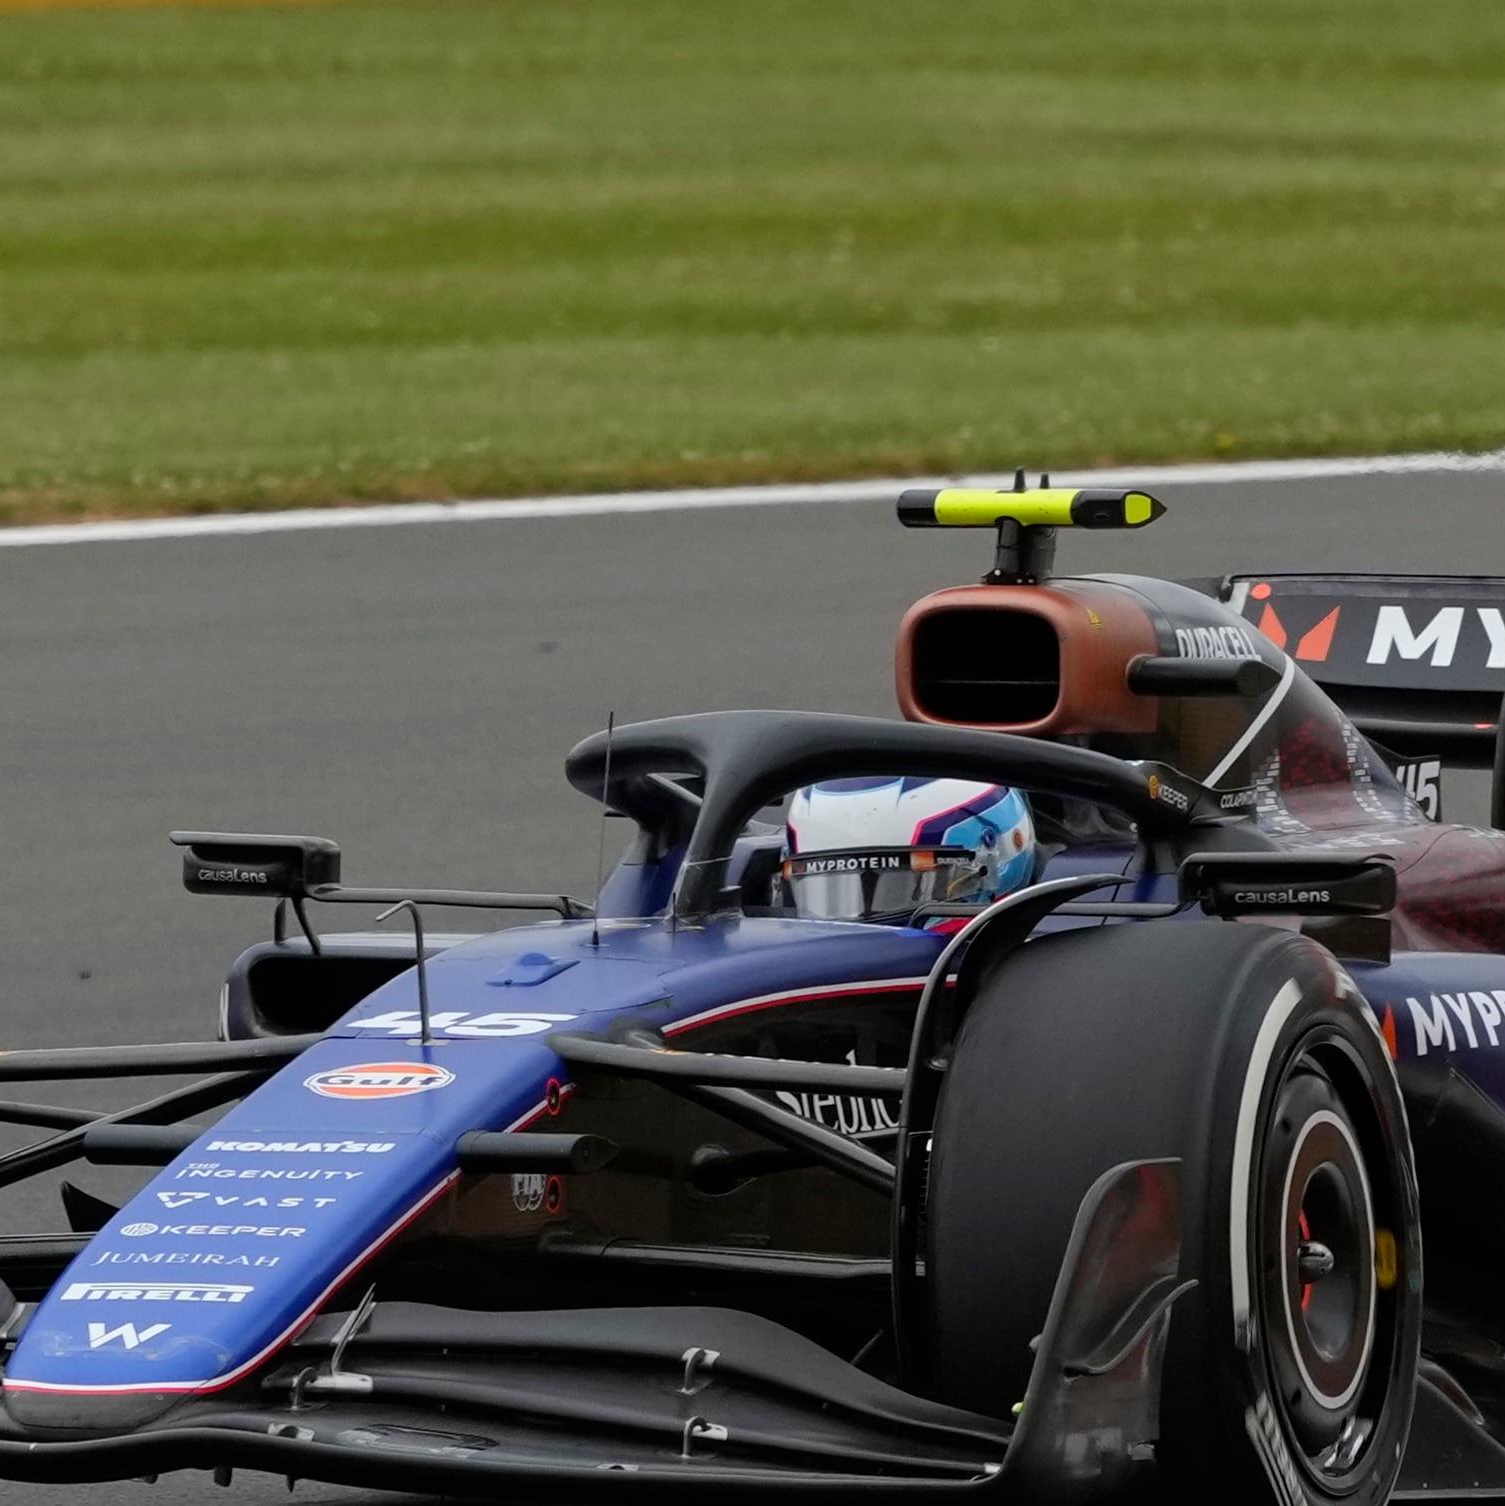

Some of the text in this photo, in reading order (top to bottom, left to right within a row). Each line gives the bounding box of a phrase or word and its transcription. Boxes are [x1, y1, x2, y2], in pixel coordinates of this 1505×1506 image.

[1175, 626, 1262, 661] DURACELL
[1159, 785, 1189, 811] KEEPER
[806, 856, 900, 873] MYPROTEIN
[198, 868, 268, 884] causaLens
[1234, 888, 1331, 904] causaLens
[346, 1011, 579, 1037] 45
[315, 1073, 445, 1087] Gulf
[205, 1140, 396, 1153] KOMATSU
[174, 1168, 364, 1181] INGENUITY
[213, 1195, 337, 1208] VAST
[159, 1224, 307, 1238] KEEPER
[90, 1251, 281, 1268] JUMEIRAH
[60, 1282, 255, 1303] PIRELLI
[87, 1322, 173, 1350] W
